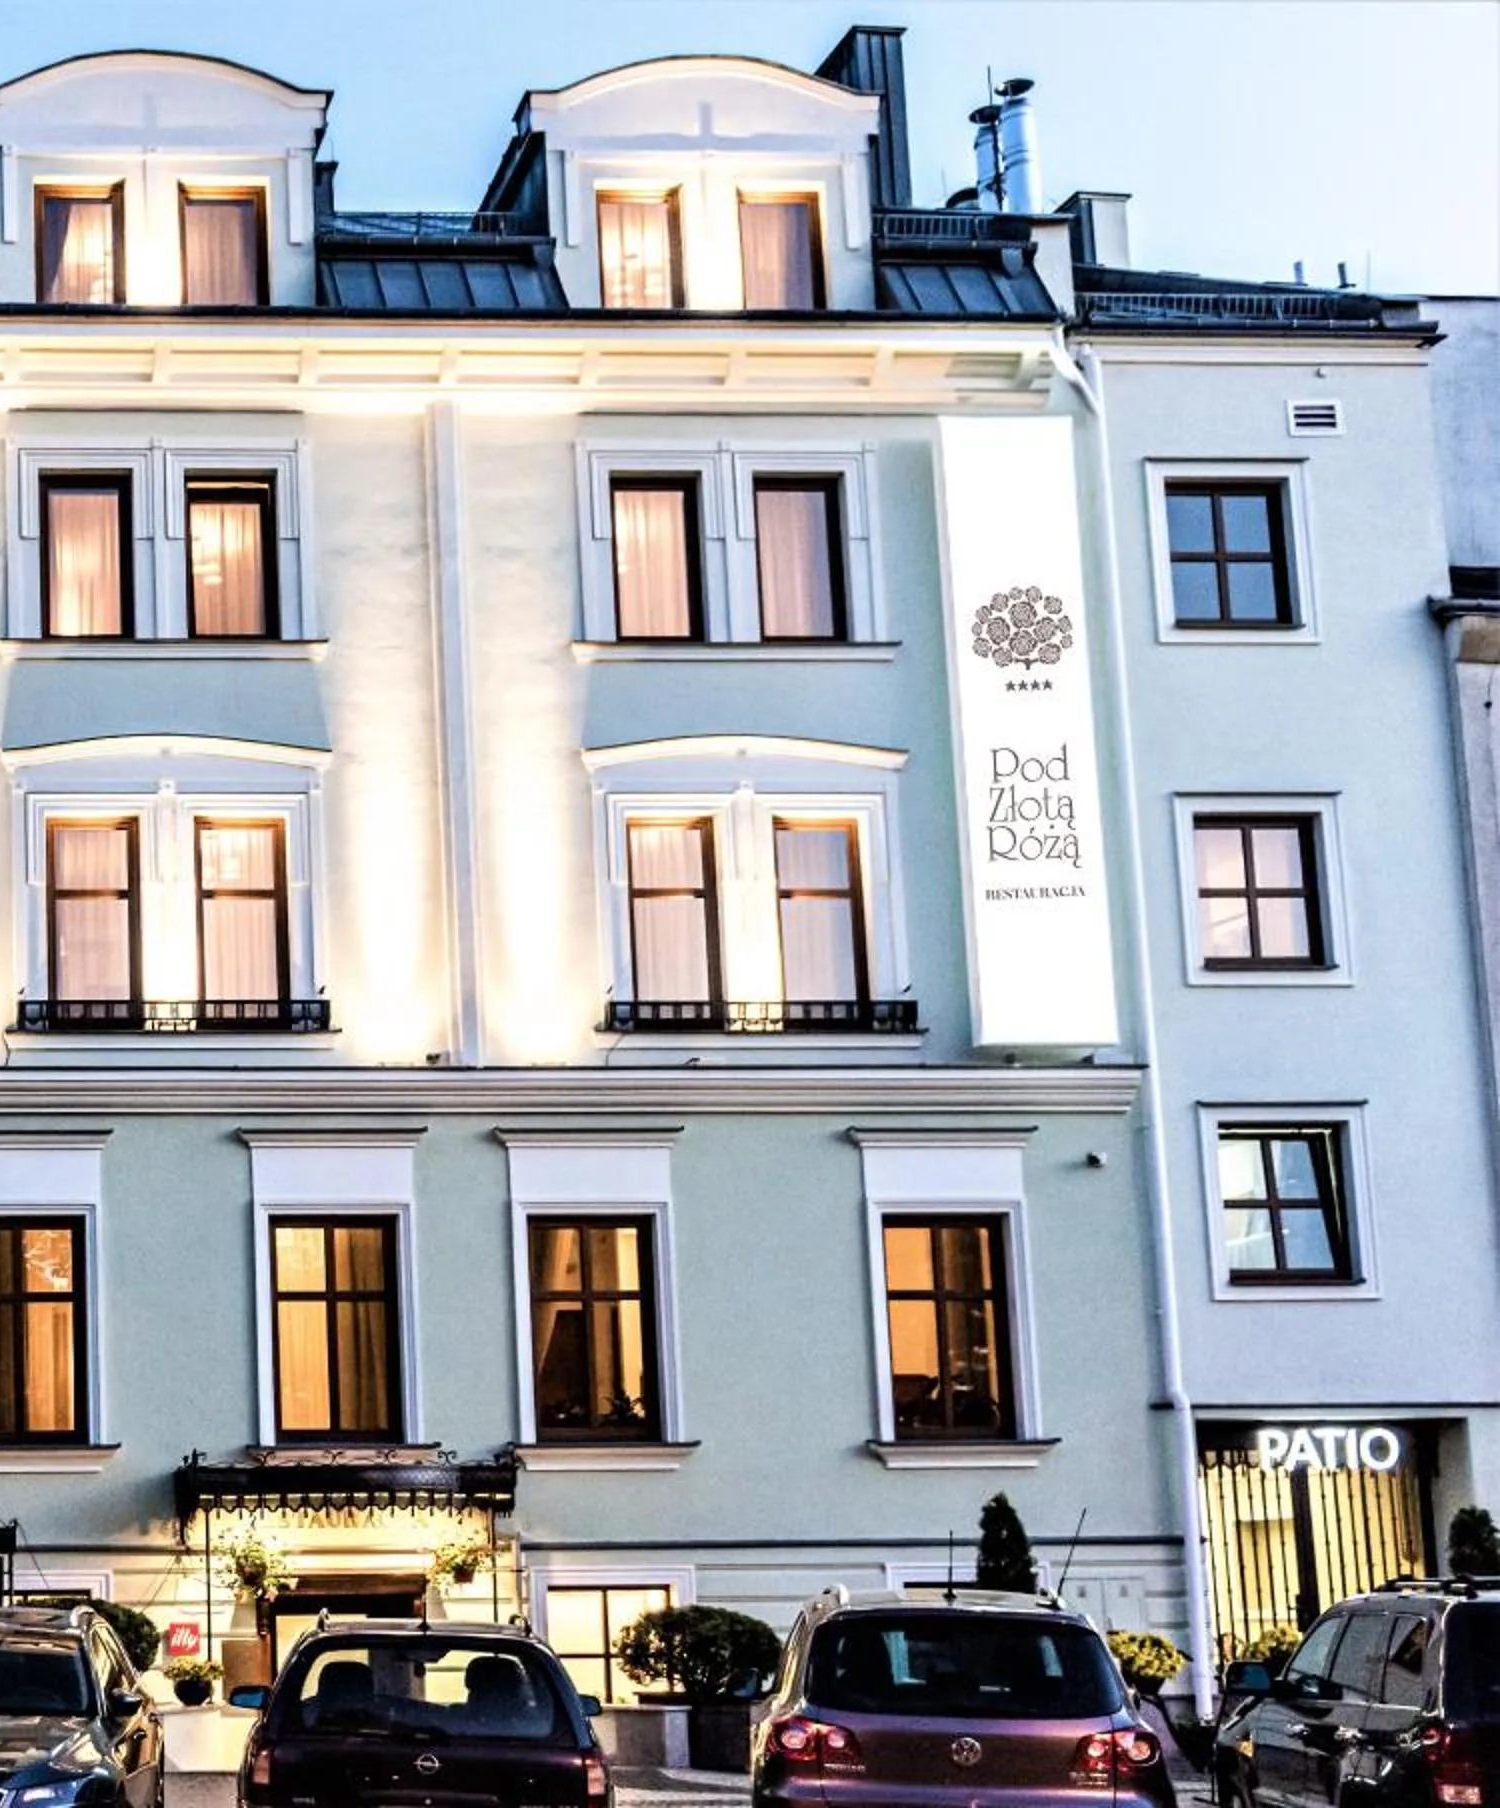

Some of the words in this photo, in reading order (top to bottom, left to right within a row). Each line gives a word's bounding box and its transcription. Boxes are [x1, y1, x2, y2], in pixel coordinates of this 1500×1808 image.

[990, 743, 1070, 783] Pod
[989, 784, 1076, 830] Złotą
[986, 824, 1082, 868] Różą
[985, 886, 1086, 901] RESTAURACJA
[1257, 1427, 1400, 1472] PATIO
